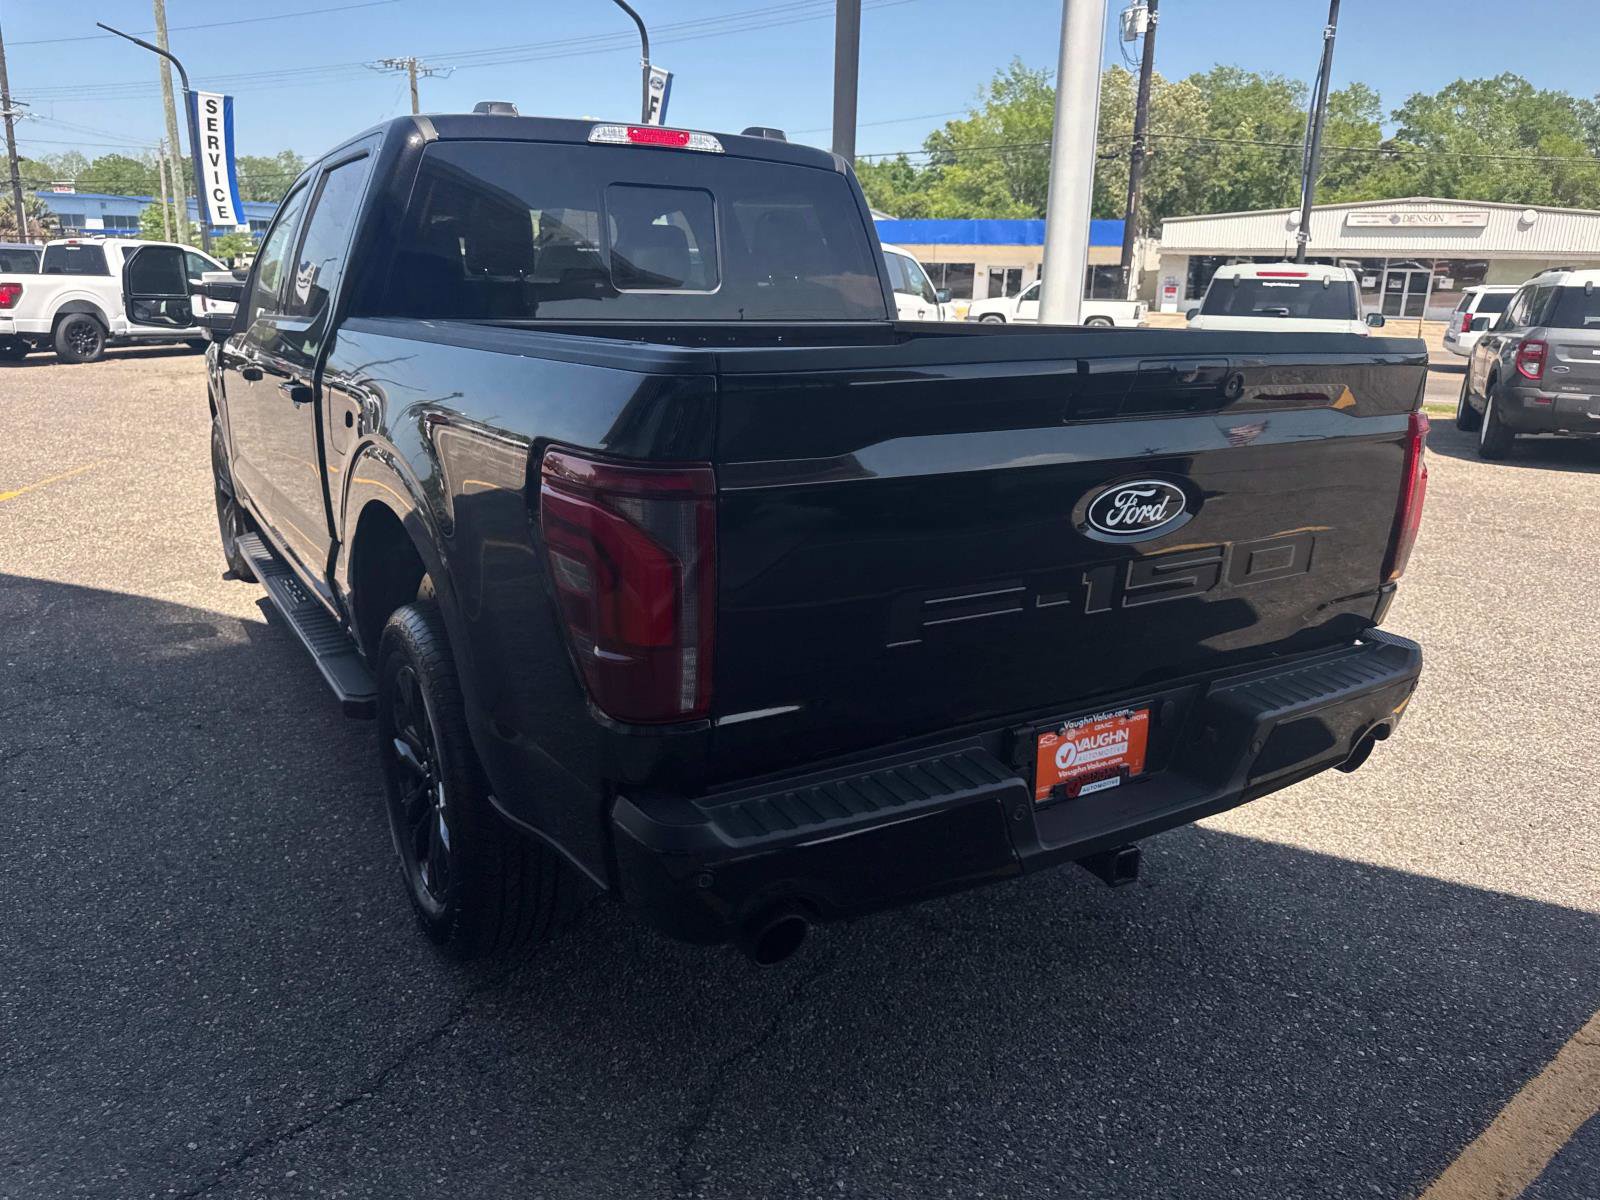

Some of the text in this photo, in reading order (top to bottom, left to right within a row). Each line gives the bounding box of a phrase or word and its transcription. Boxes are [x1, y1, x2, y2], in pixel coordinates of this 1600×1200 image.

[205, 99, 229, 219] SERVICE
[1402, 213, 1445, 223] DENSON
[1106, 488, 1170, 527] Ford
[885, 536, 1316, 648] F-150
[1064, 709, 1129, 729] VaughnValue.com
[1075, 728, 1129, 751] VAUGHN
[1058, 757, 1123, 778] VaughnValue.com
[1082, 778, 1119, 793] AUTOMOTIVE
